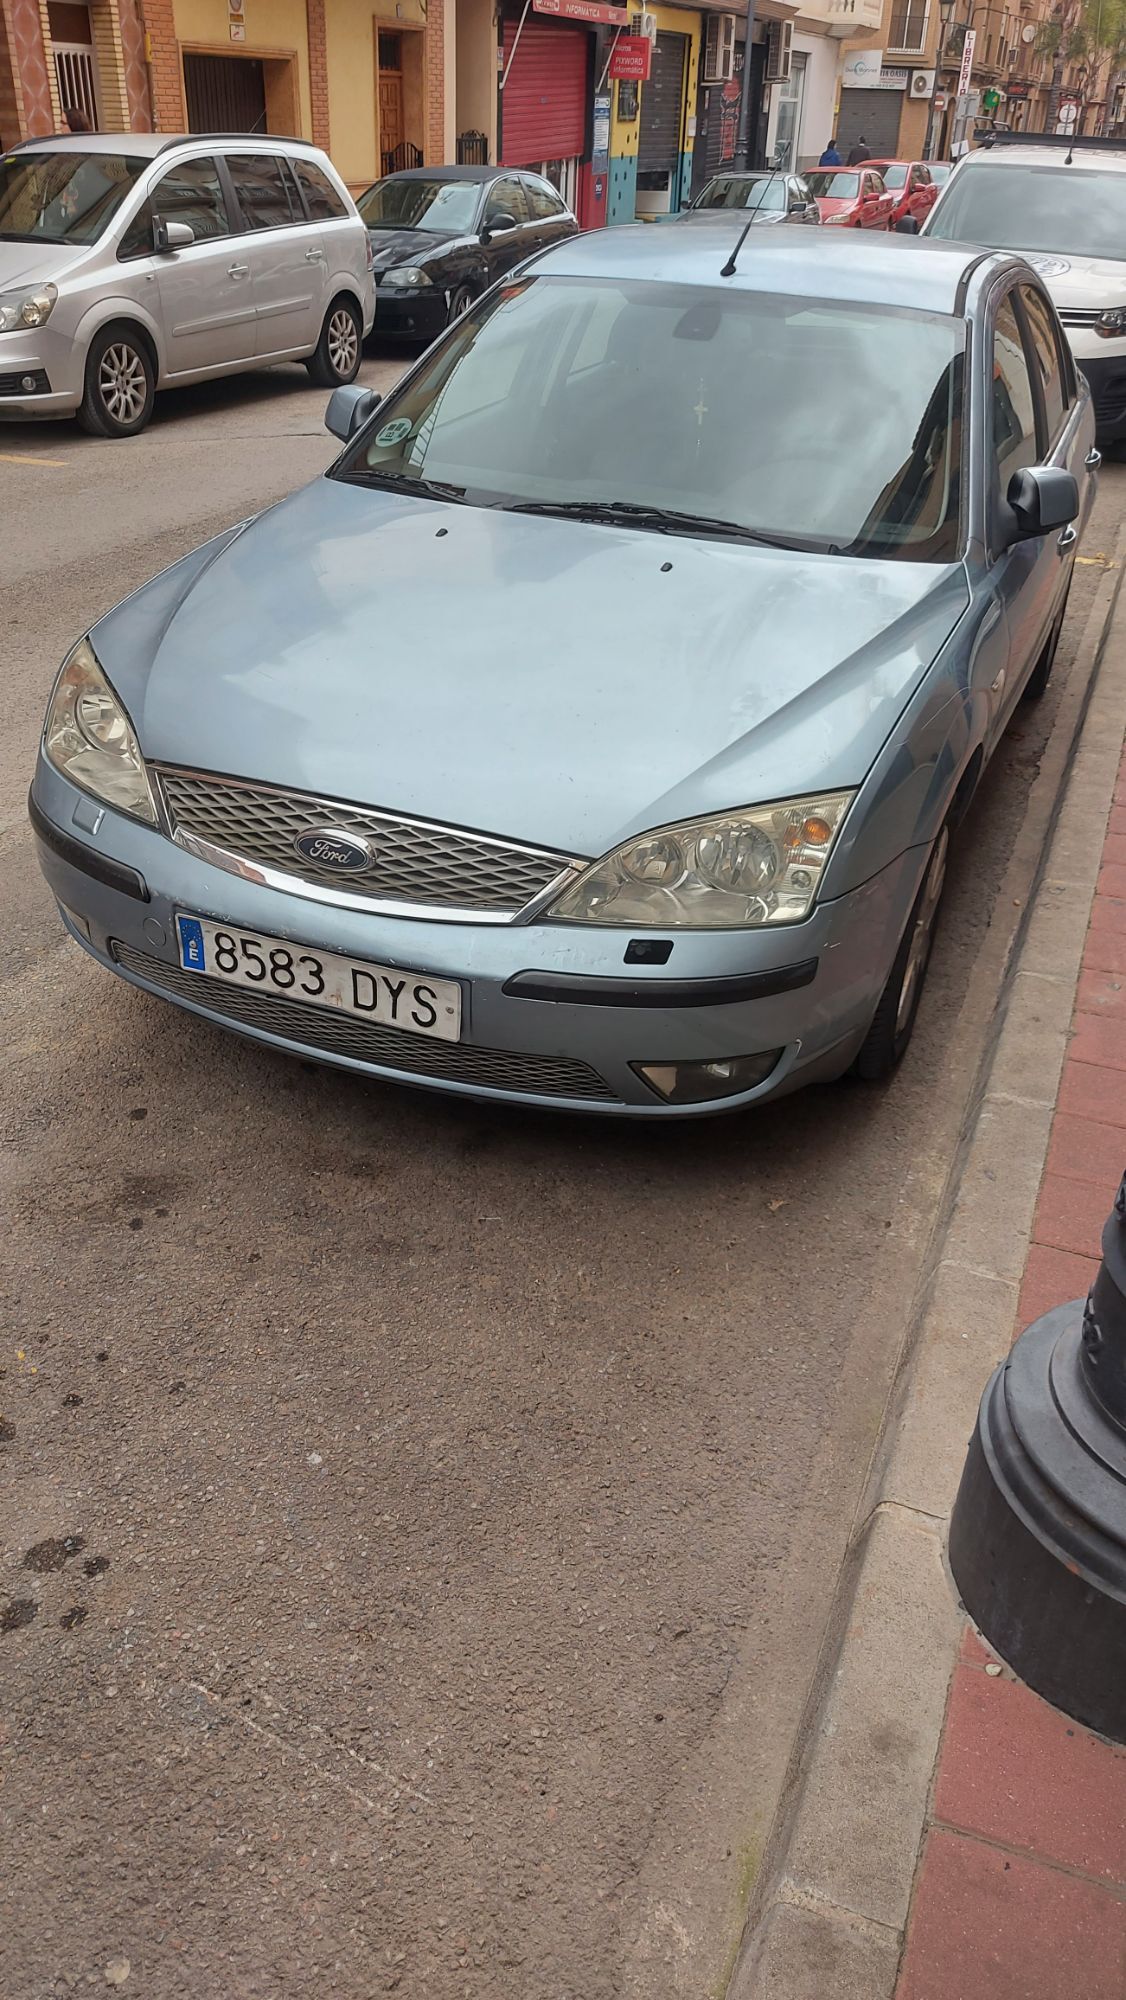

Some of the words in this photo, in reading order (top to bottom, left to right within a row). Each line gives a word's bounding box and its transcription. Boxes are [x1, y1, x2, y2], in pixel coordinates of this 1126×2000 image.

[310, 840, 352, 863] Ford
[189, 948, 199, 961] E
[214, 932, 325, 995] 8583
[351, 968, 437, 1027] DYS
